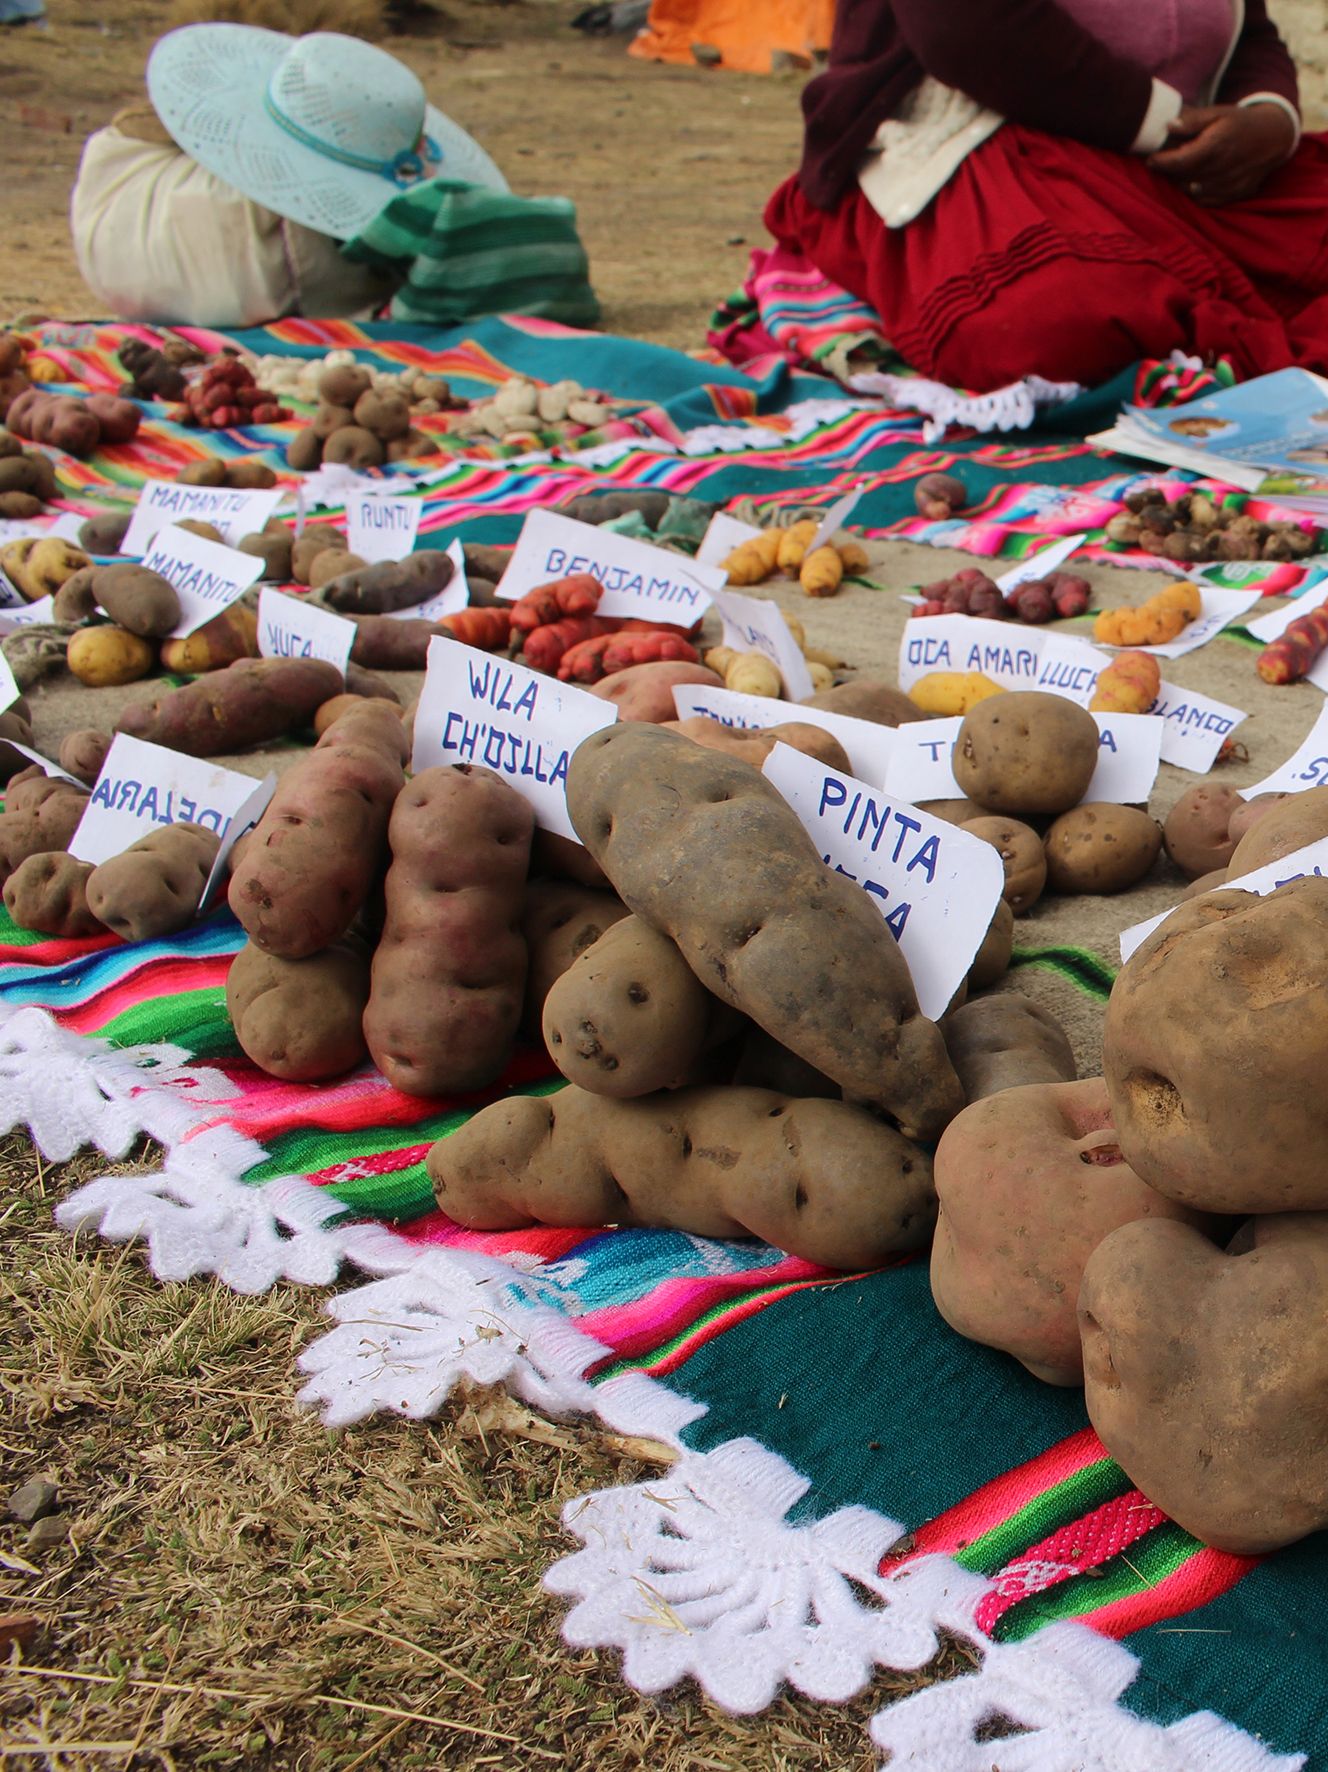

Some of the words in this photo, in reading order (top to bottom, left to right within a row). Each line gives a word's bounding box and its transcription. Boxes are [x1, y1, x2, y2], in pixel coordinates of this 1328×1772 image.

[361, 502, 414, 531] RUNTU
[545, 548, 701, 606] BENJAMIN
[907, 638, 951, 667] OCA
[468, 660, 539, 722] WILA
[819, 777, 941, 884] PINTA
